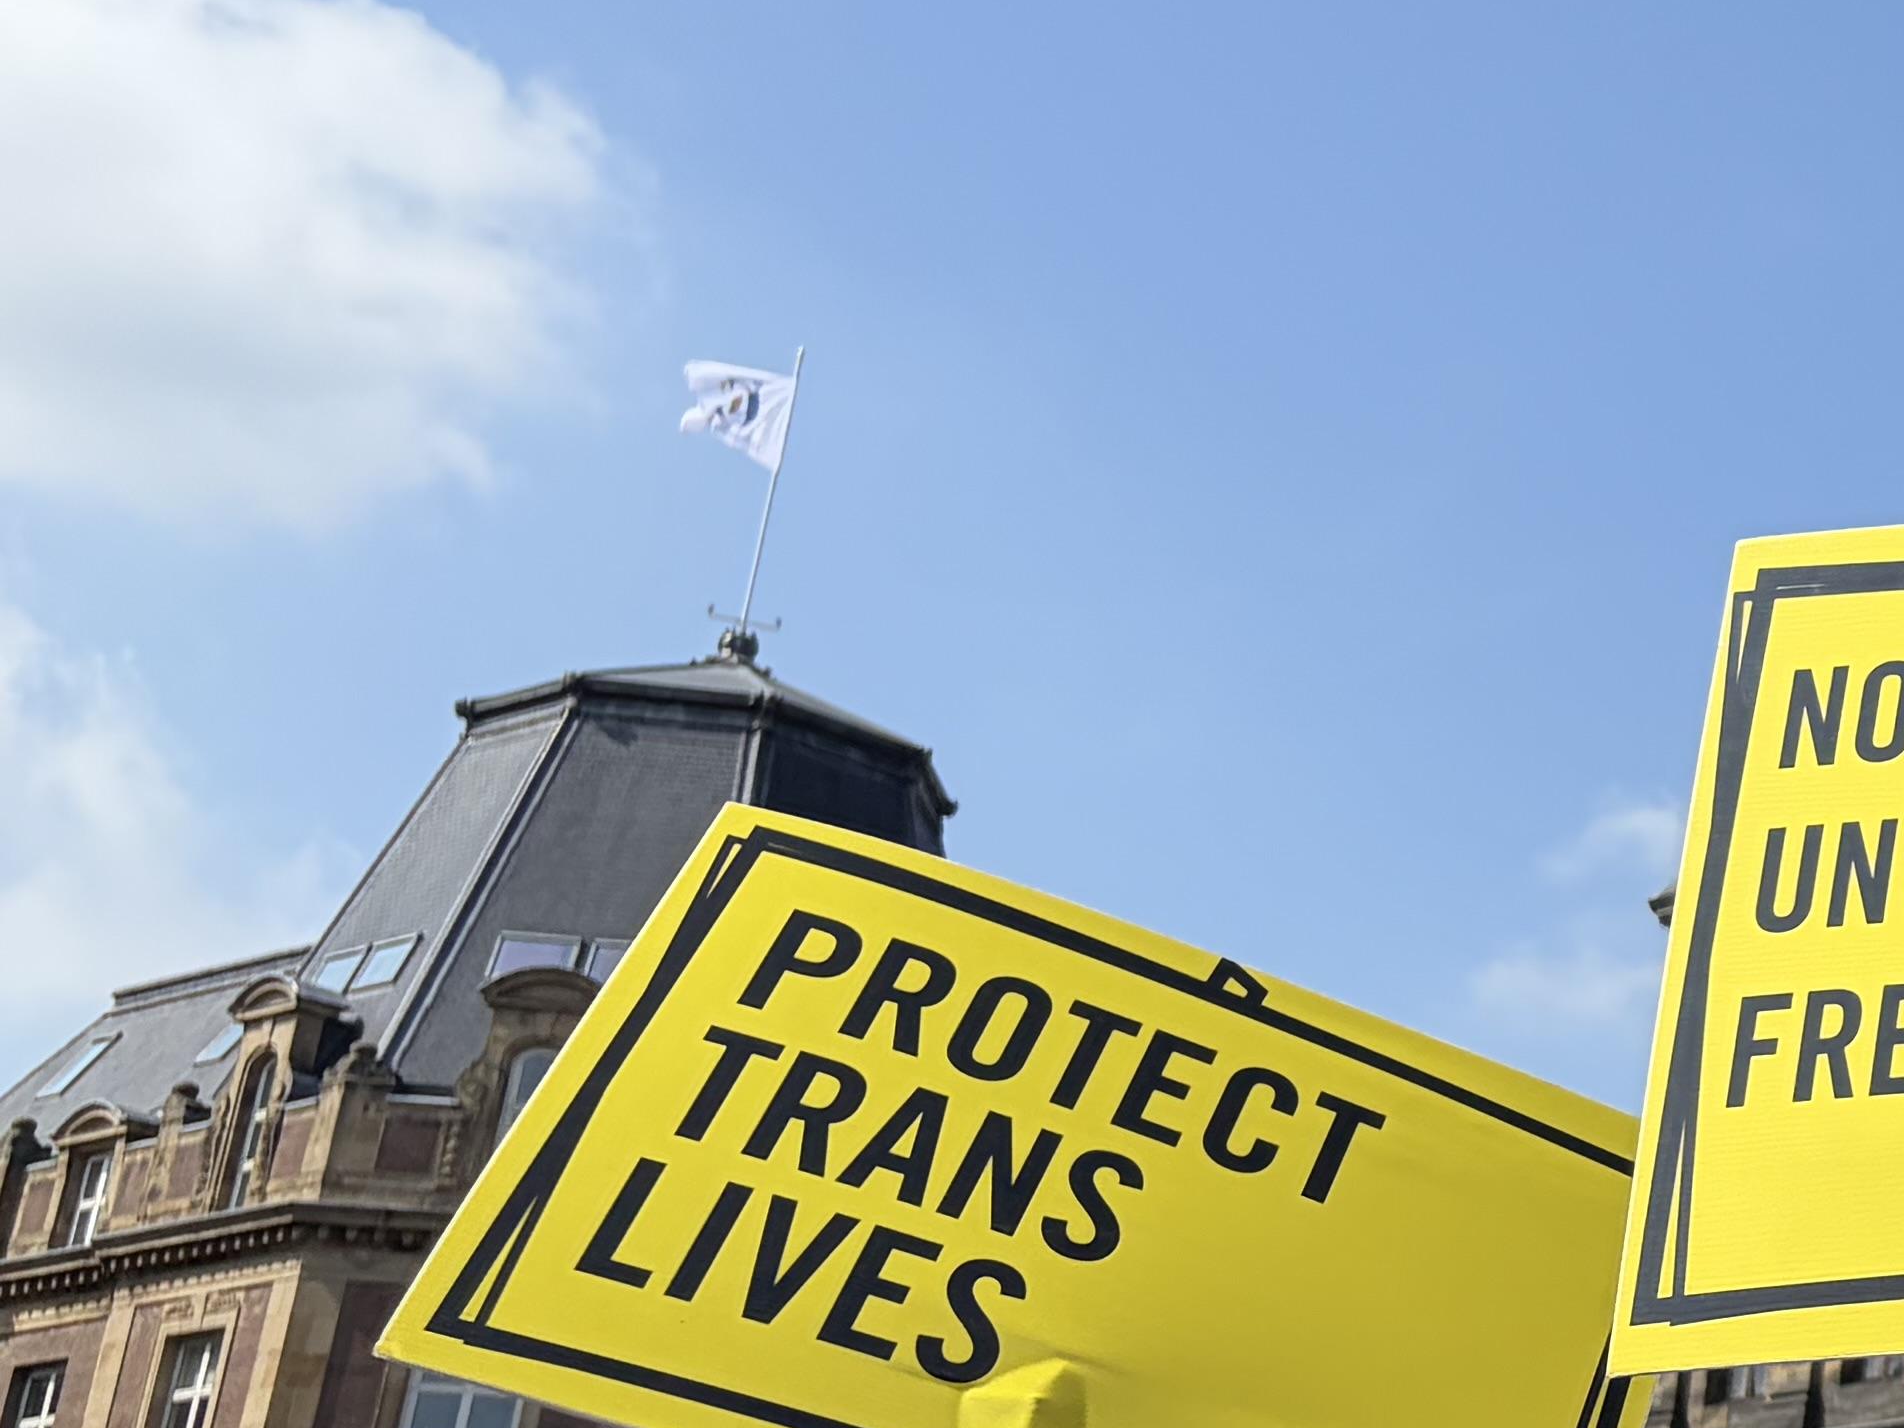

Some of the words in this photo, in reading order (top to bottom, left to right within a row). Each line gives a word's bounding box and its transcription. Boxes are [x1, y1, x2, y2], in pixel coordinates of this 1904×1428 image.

[674, 1025, 1144, 1262] TRANS
[736, 909, 1387, 1204] PROTECT
[574, 1157, 1027, 1384] LIVES
